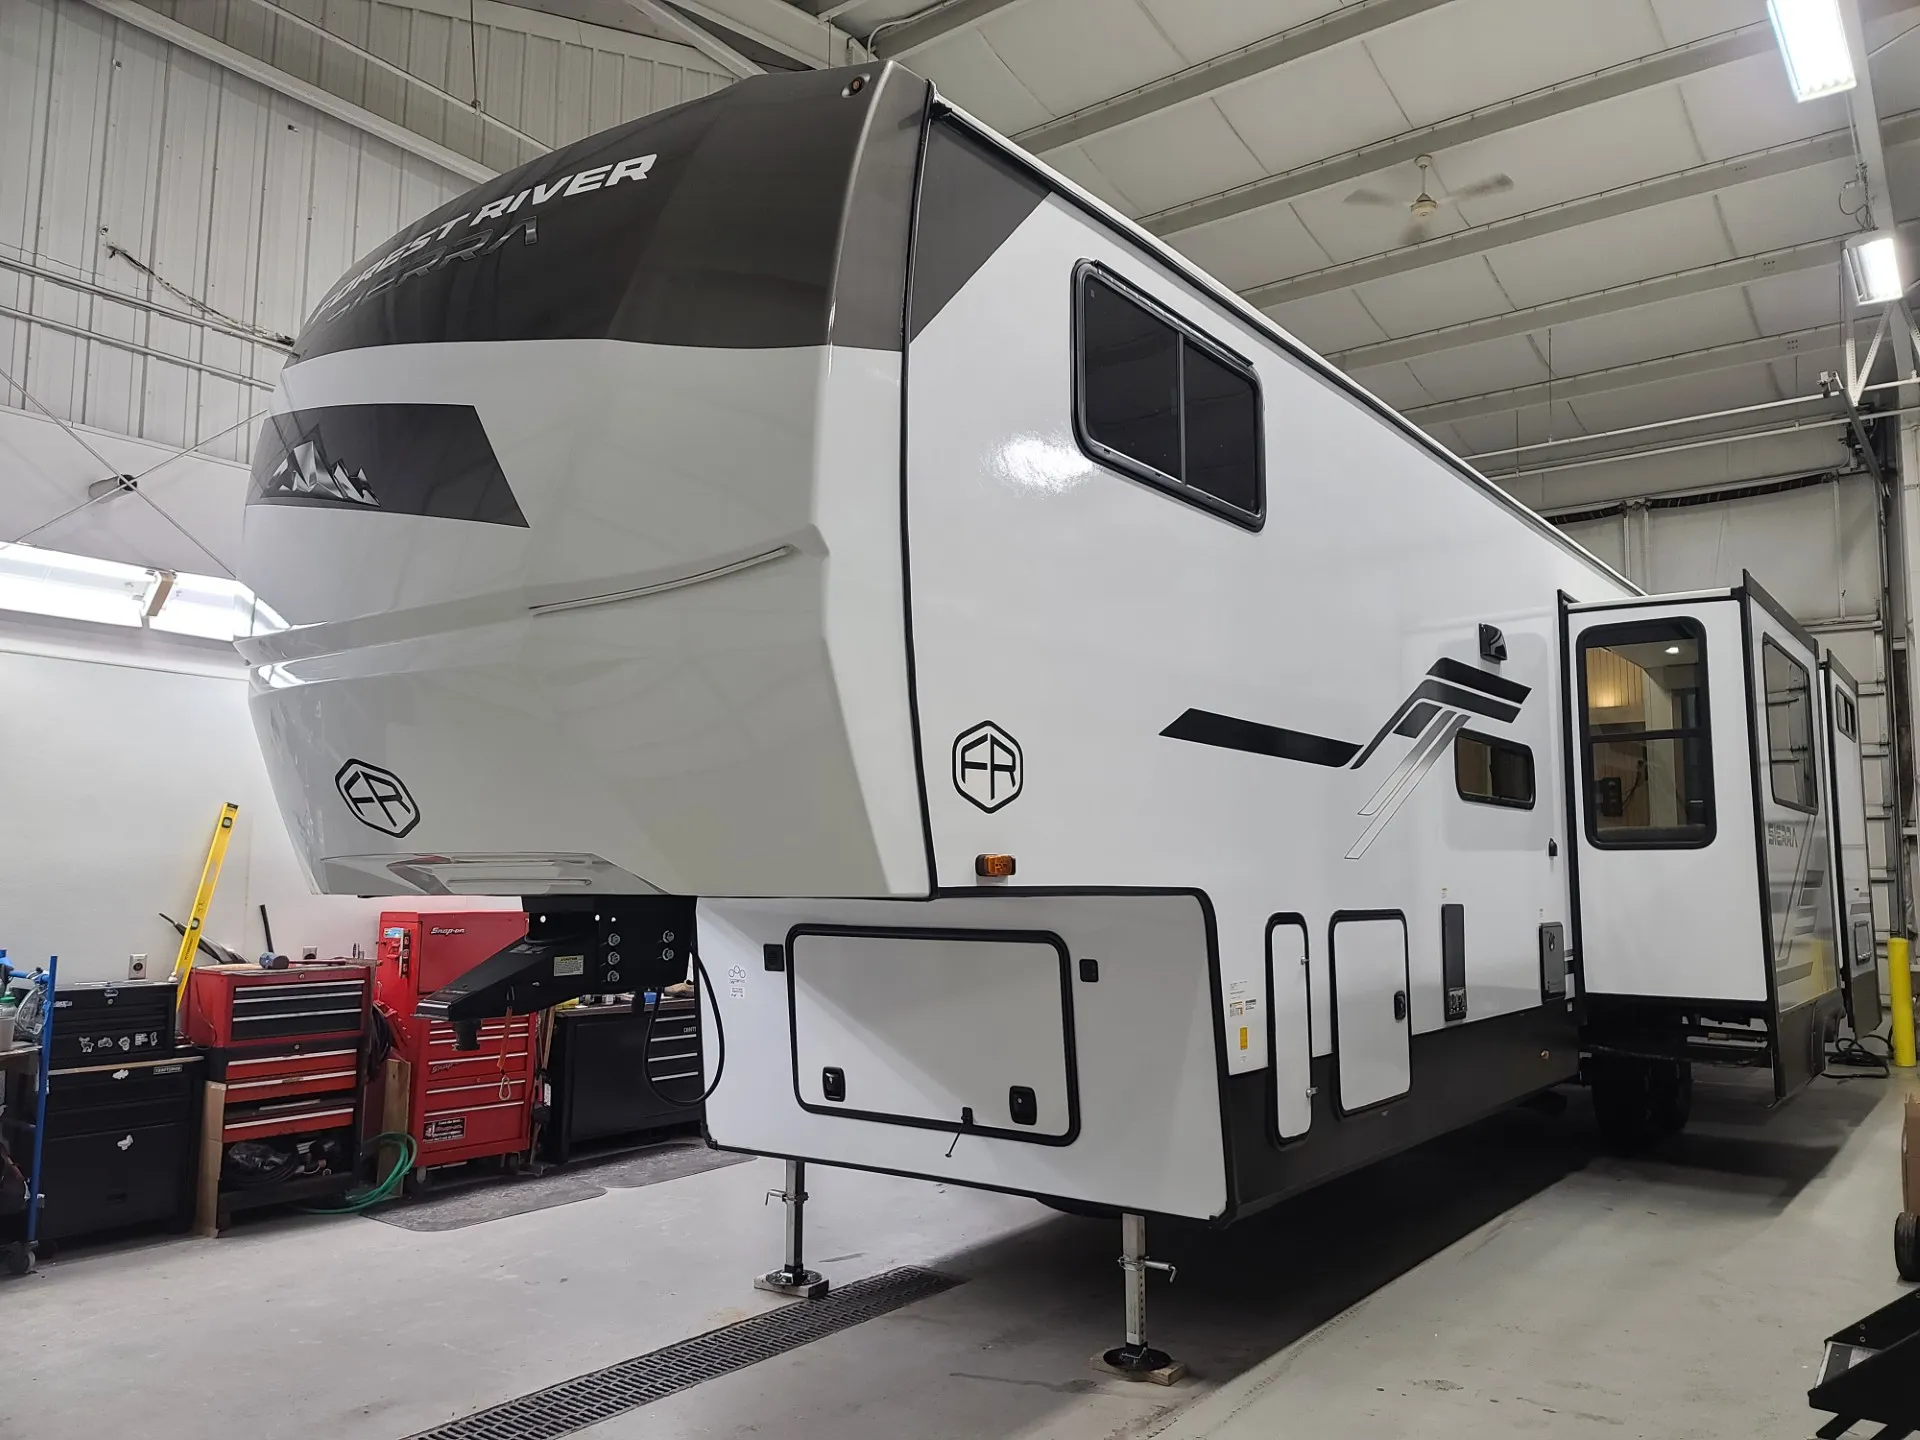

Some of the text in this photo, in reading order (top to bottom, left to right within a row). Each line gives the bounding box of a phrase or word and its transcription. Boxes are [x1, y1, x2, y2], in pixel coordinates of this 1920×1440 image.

[311, 153, 658, 325] FOREST RIVER
[961, 732, 1016, 801] FR
[1768, 822, 1798, 848] SIERRA
[430, 926, 466, 937] Snap-on
